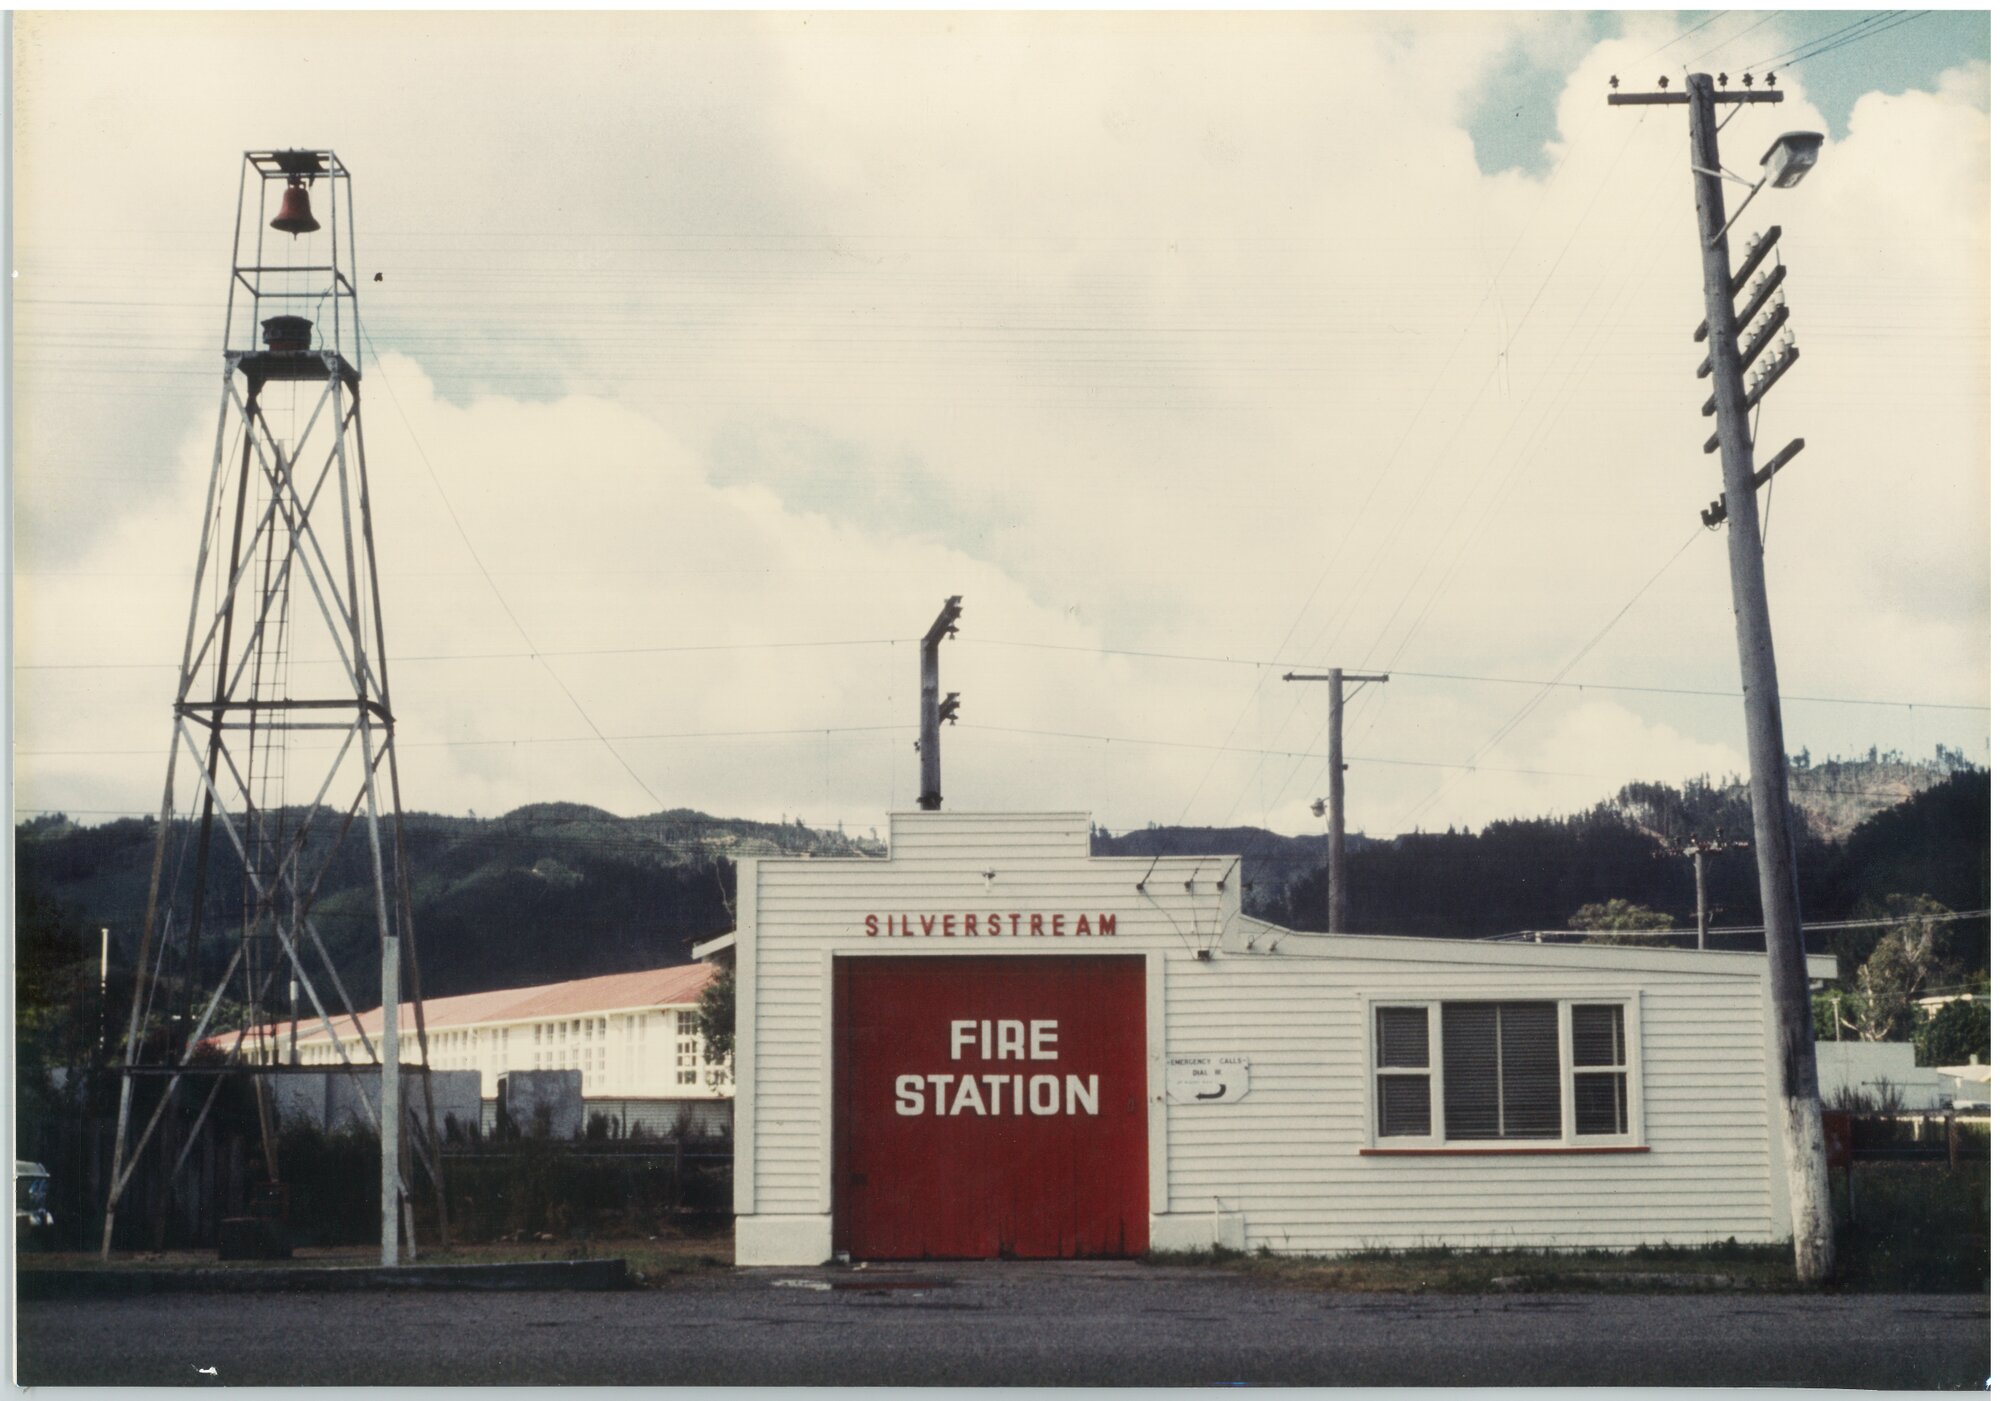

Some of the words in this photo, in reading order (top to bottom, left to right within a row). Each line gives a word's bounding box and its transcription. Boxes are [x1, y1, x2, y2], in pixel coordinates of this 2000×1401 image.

[865, 913, 1117, 937] SILVERSTREAM
[950, 1019, 1059, 1060] FIRE
[1170, 1058, 1211, 1066] EMERGENCY
[1219, 1057, 1242, 1065] CALLS
[1192, 1069, 1208, 1077] DIAL
[895, 1074, 1099, 1116] STATION
